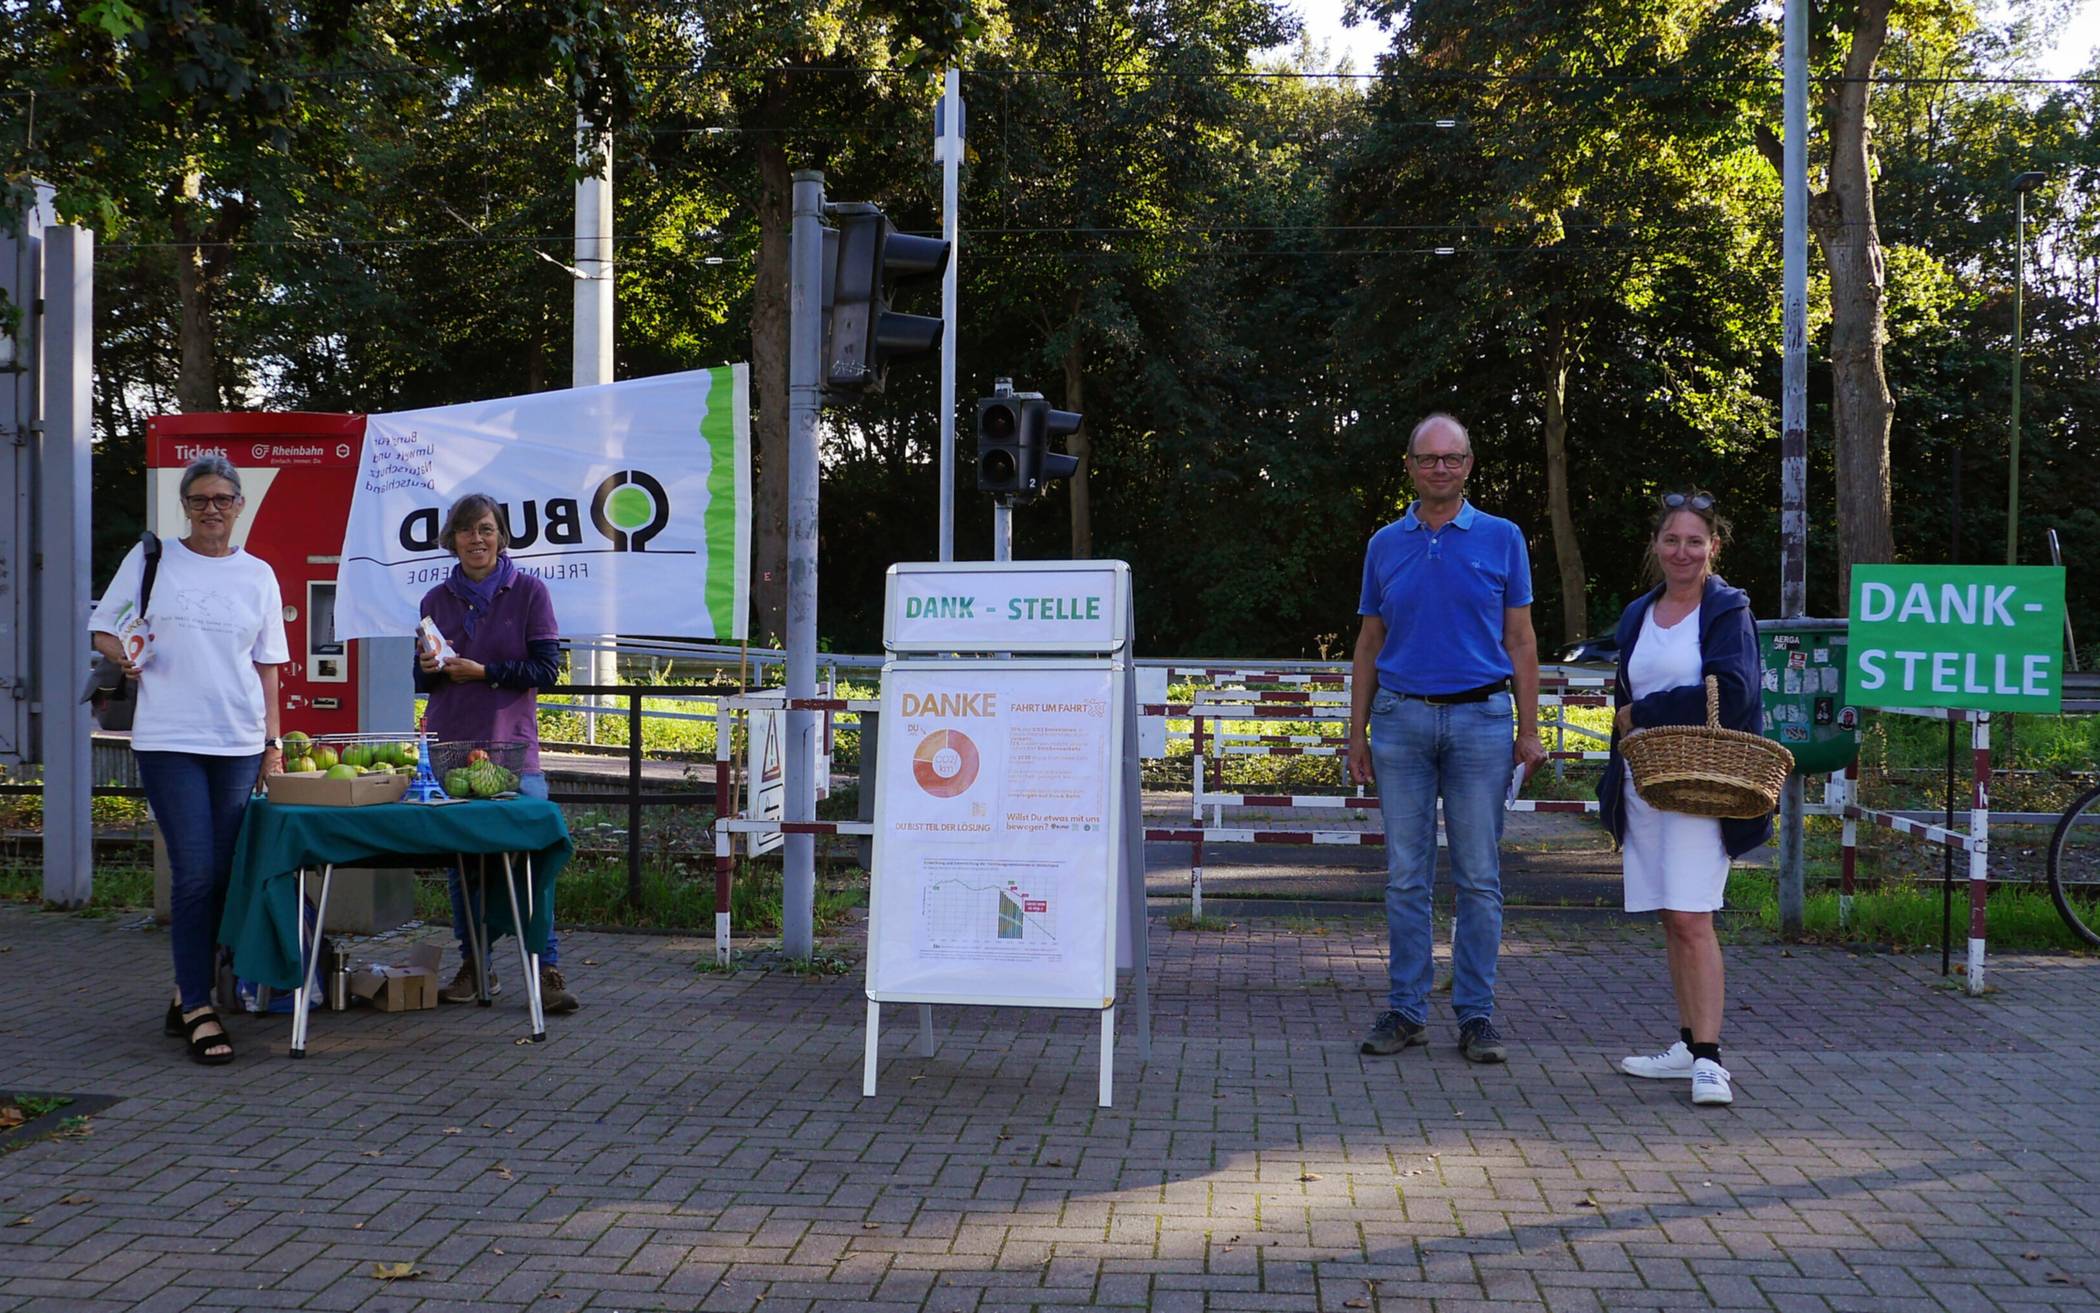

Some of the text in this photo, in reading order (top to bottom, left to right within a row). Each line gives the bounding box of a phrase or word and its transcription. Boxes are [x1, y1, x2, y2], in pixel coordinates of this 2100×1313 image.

[174, 444, 228, 460] Tickets
[272, 445, 324, 456] Rheinbahn
[1029, 478, 1036, 488] 2
[906, 596, 976, 619] DANK
[1007, 596, 1101, 620] STELLE
[1858, 649, 2051, 696] STELLE
[901, 692, 997, 717] DANKE
[1010, 703, 1088, 713] FAHRT UM FAHRT
[907, 723, 919, 732] DU
[1007, 813, 1029, 821] Willst
[1031, 813, 1042, 821] Du
[926, 823, 939, 831] TEIL
[941, 823, 956, 832] DER
[1006, 822, 1049, 832] bewegen?
